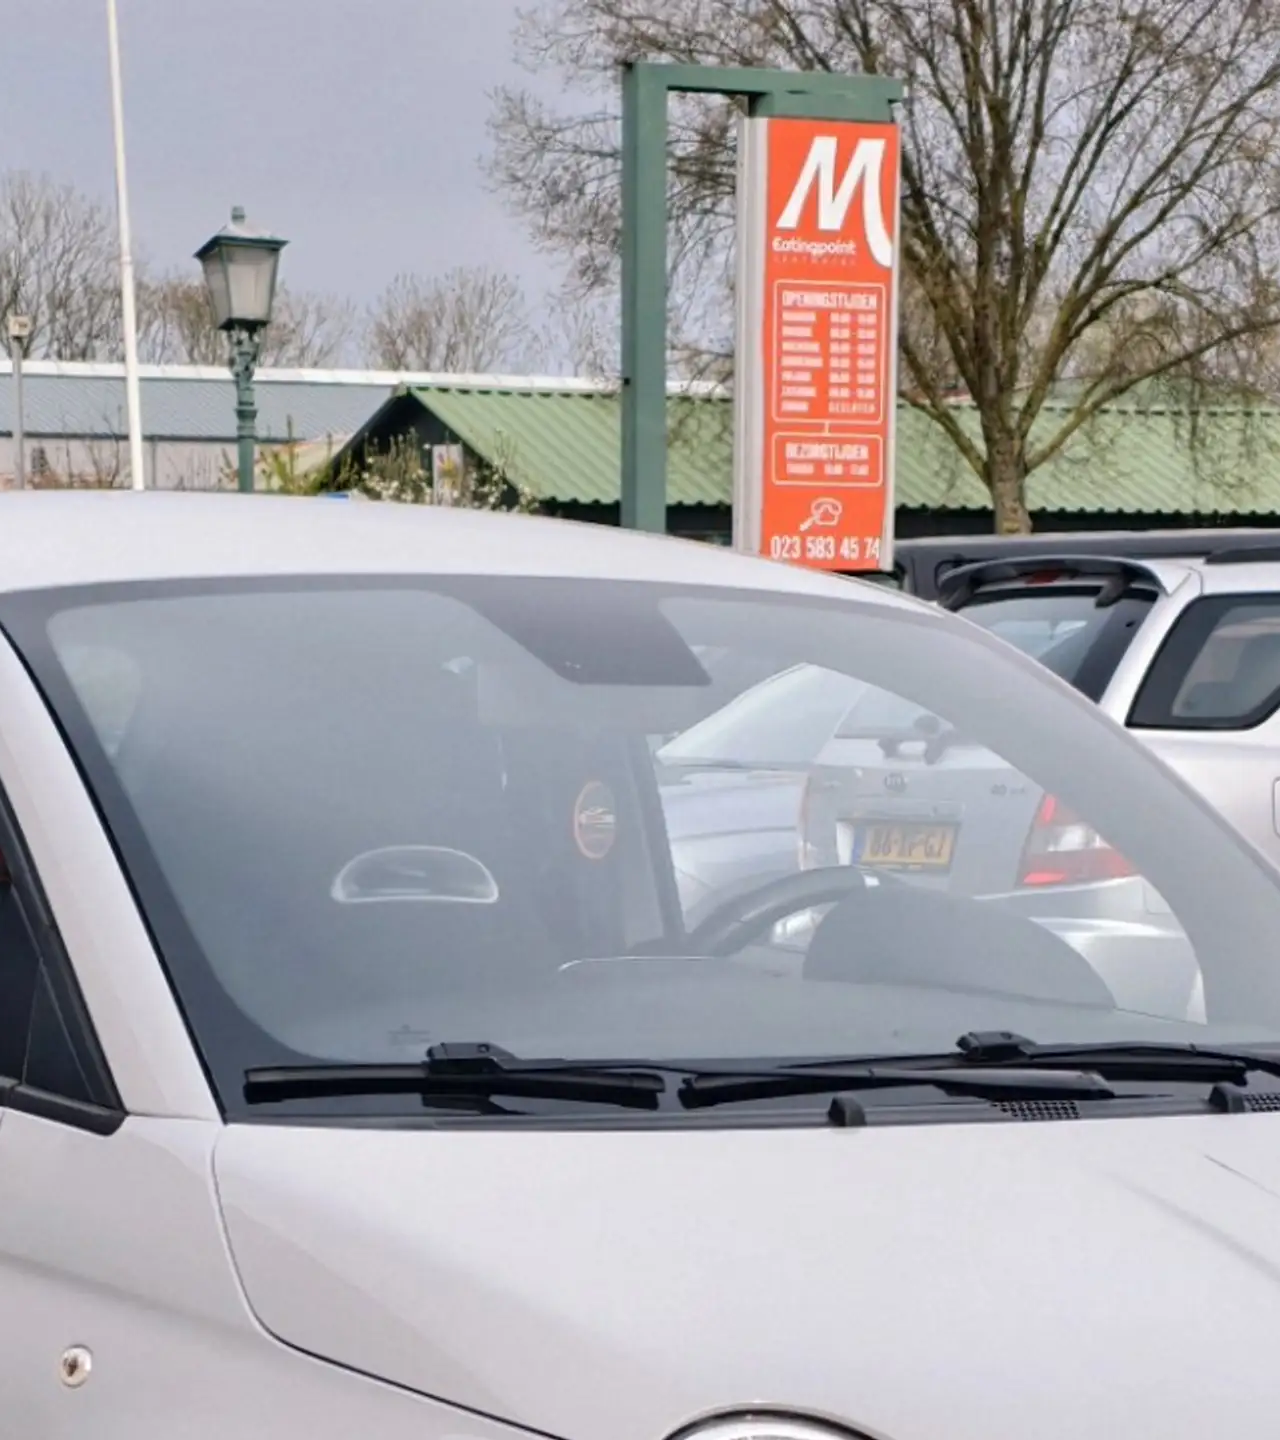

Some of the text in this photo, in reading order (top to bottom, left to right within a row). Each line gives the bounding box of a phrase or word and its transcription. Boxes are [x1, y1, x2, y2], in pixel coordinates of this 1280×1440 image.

[776, 136, 892, 268] M
[773, 236, 856, 257] Eatingpoint
[770, 534, 881, 561] 023 583 45 74
